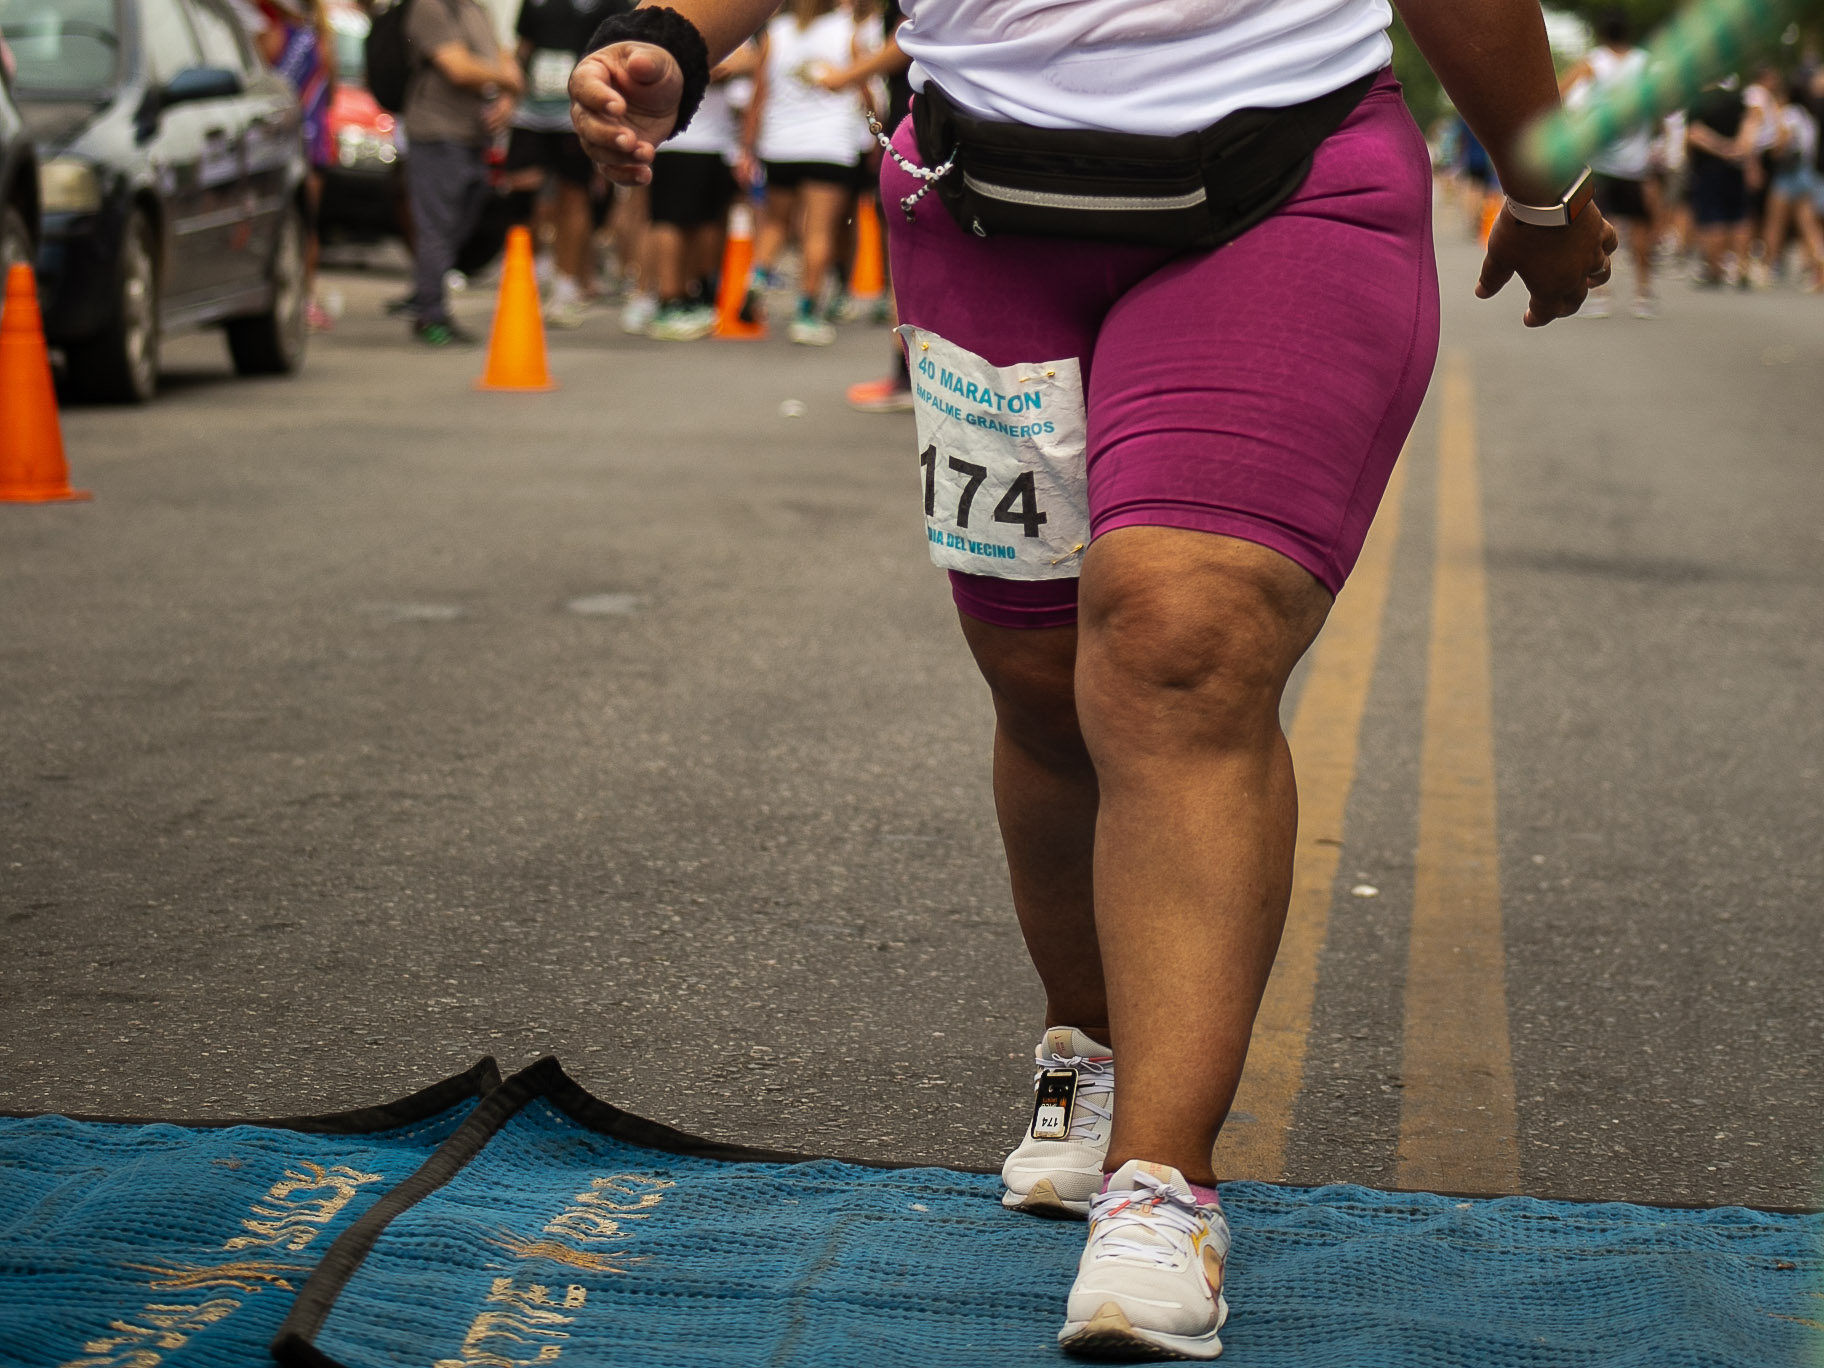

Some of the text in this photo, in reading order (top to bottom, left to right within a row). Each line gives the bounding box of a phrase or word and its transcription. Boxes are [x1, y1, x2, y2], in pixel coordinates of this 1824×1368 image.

[916, 383, 1055, 438] EMPALME GRANEROS
[918, 357, 1042, 414] 40 MARATON
[920, 443, 1048, 538] 174
[946, 532, 967, 552] DEL
[967, 539, 1016, 560] VECINO
[1041, 1116, 1058, 1128] 174
